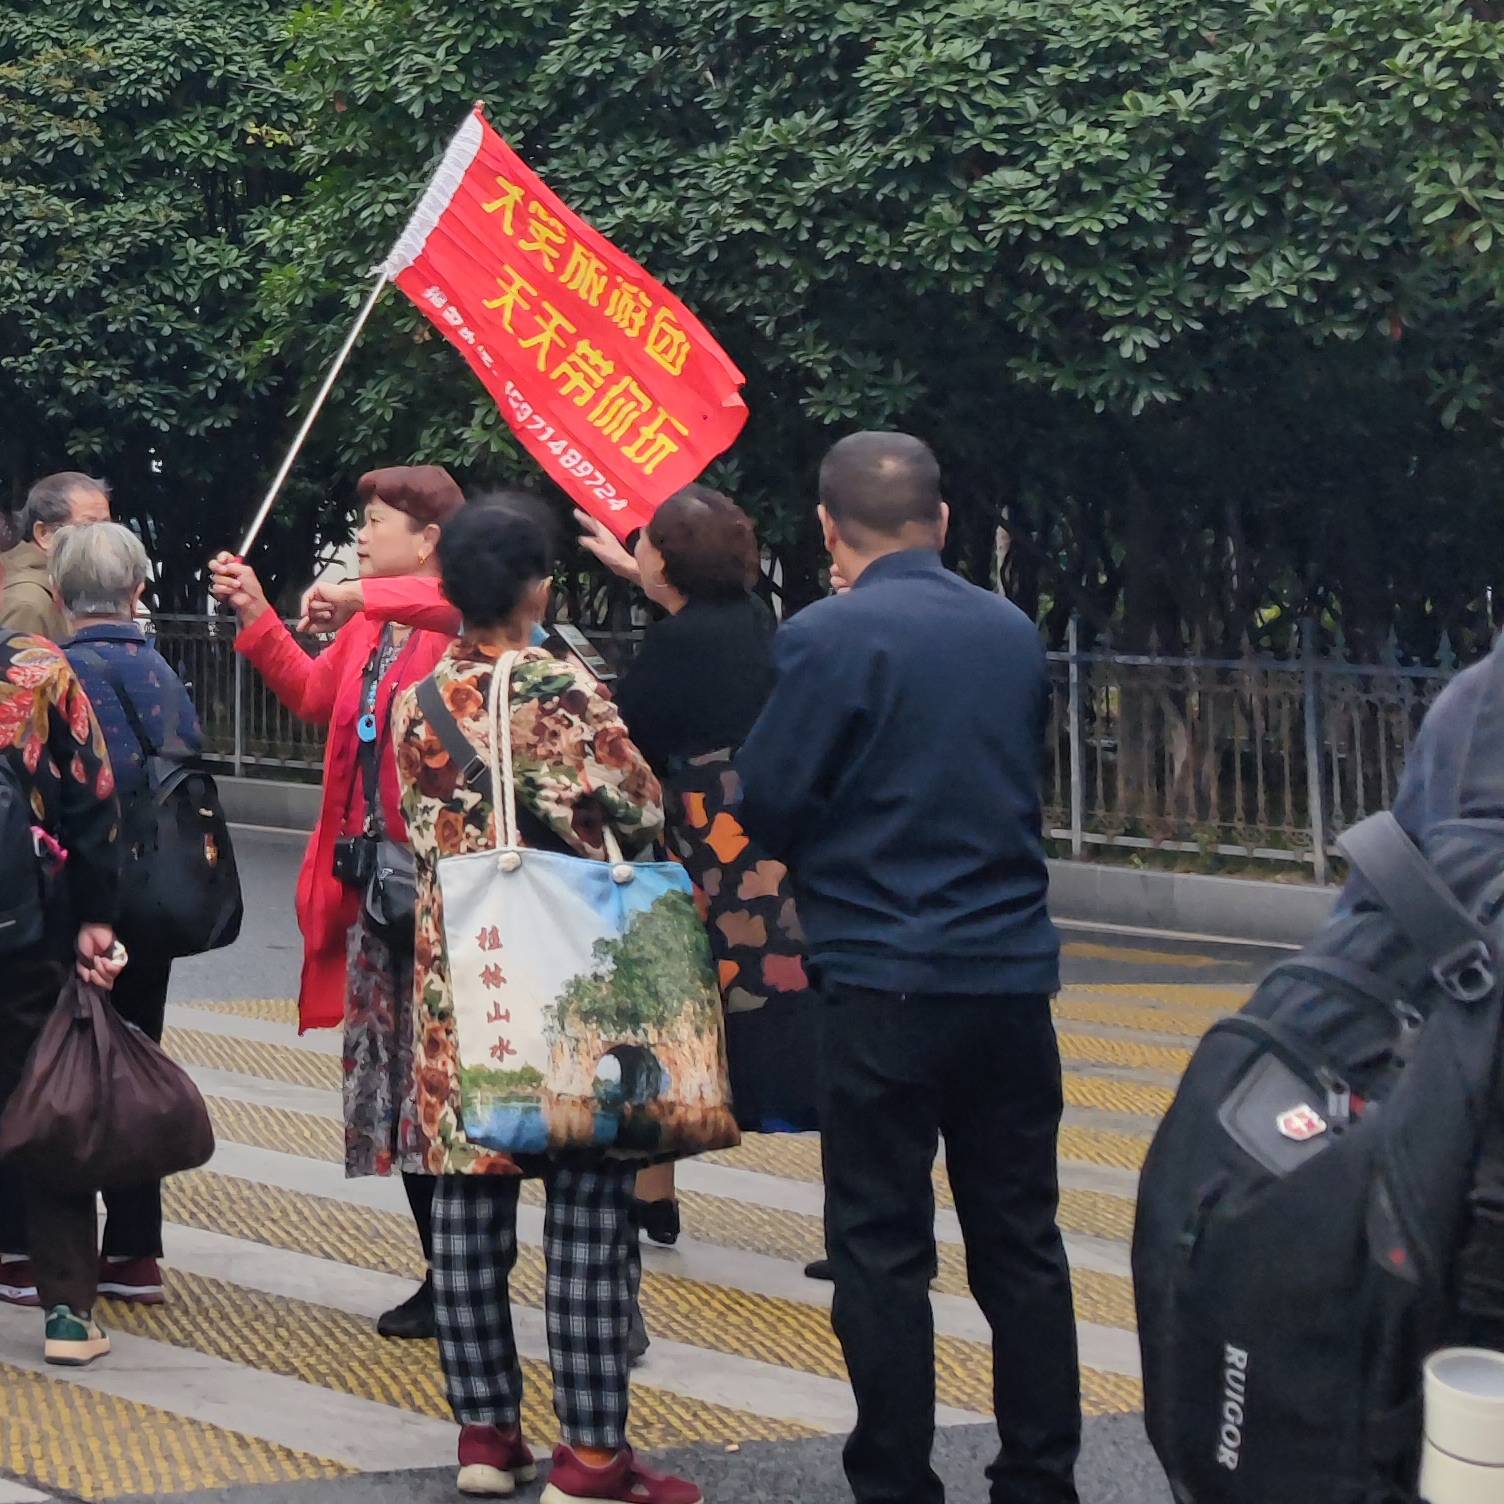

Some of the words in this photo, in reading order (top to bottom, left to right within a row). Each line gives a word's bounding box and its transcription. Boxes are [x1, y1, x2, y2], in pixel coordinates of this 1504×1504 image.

[481, 176, 691, 376] 大笑旅游团
[481, 262, 690, 475] 天天带你玩
[474, 924, 518, 1063] 桂林山水
[1216, 1340, 1249, 1471] RUIGOR
